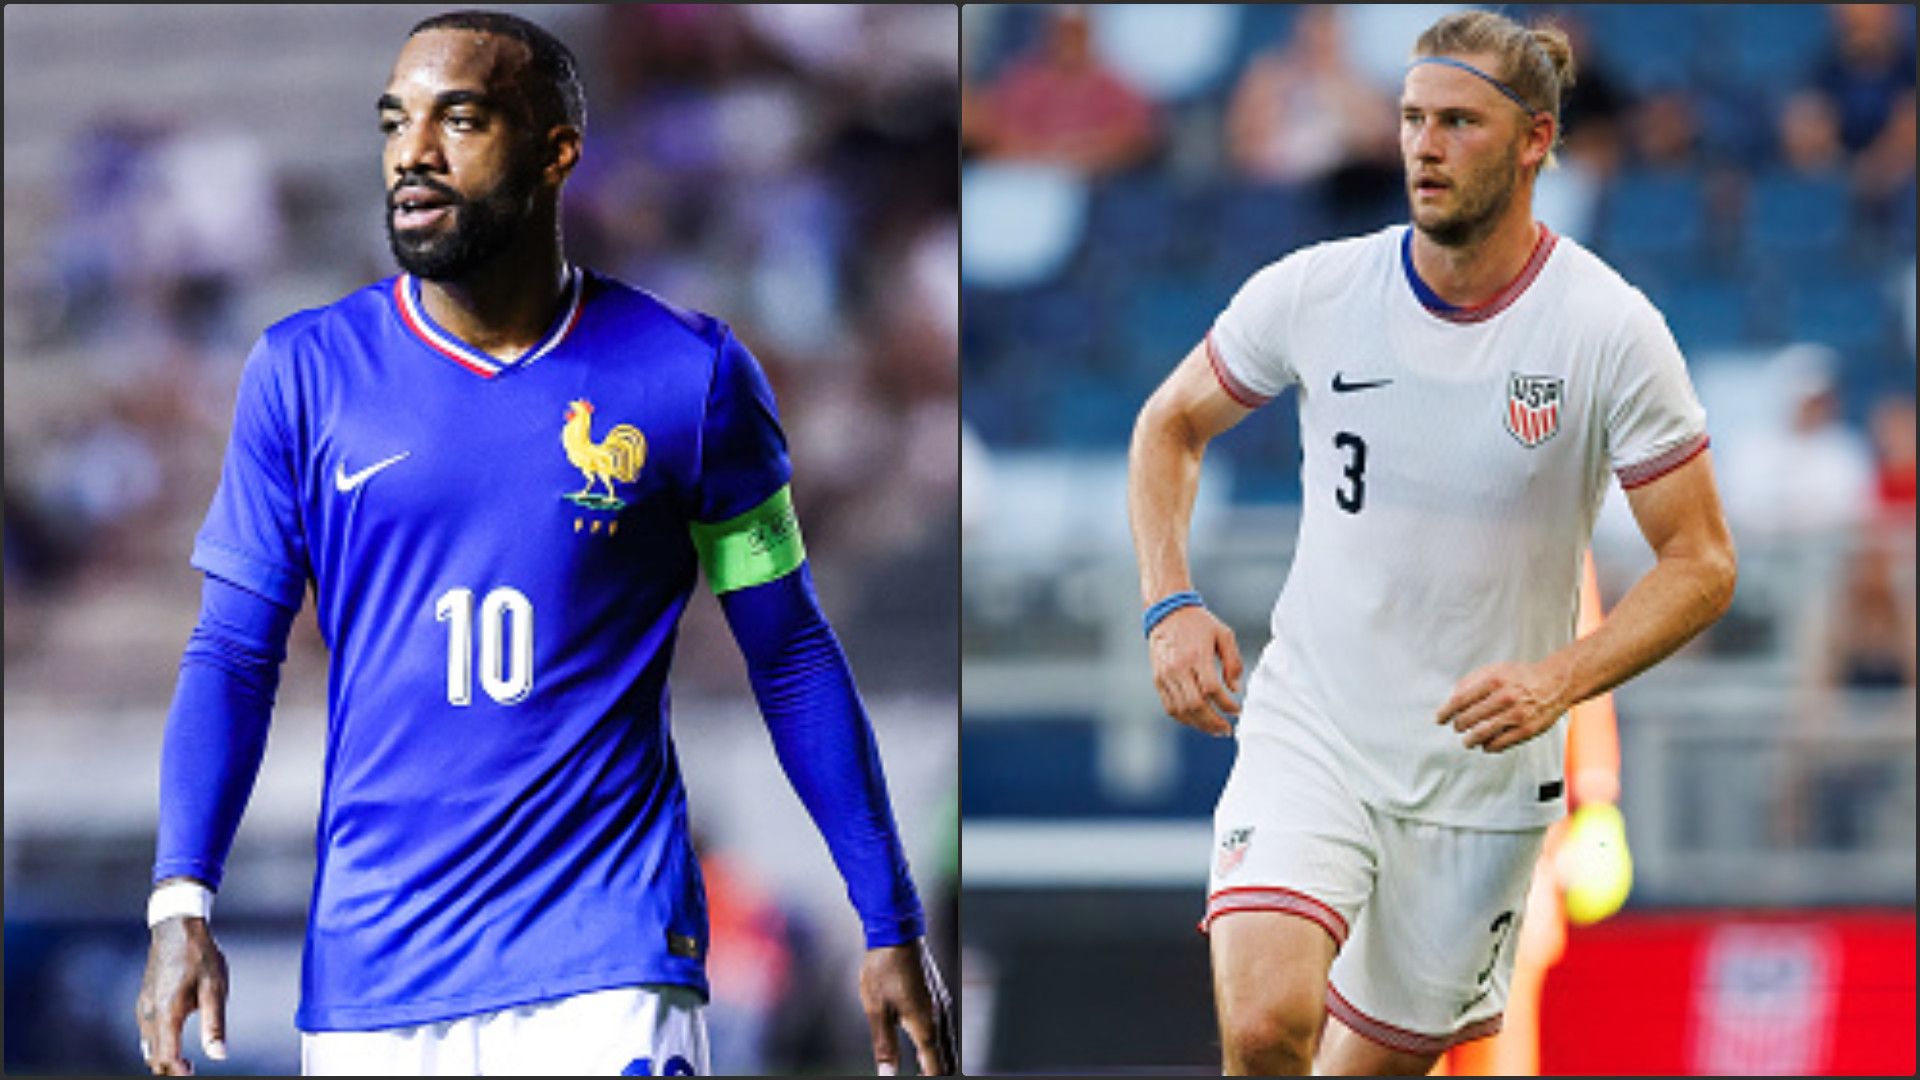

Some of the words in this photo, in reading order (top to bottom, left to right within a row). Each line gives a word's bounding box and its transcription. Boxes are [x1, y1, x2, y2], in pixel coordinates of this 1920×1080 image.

[1513, 379, 1557, 409] USA
[1333, 431, 1367, 514] 3
[435, 586, 534, 706] 10
